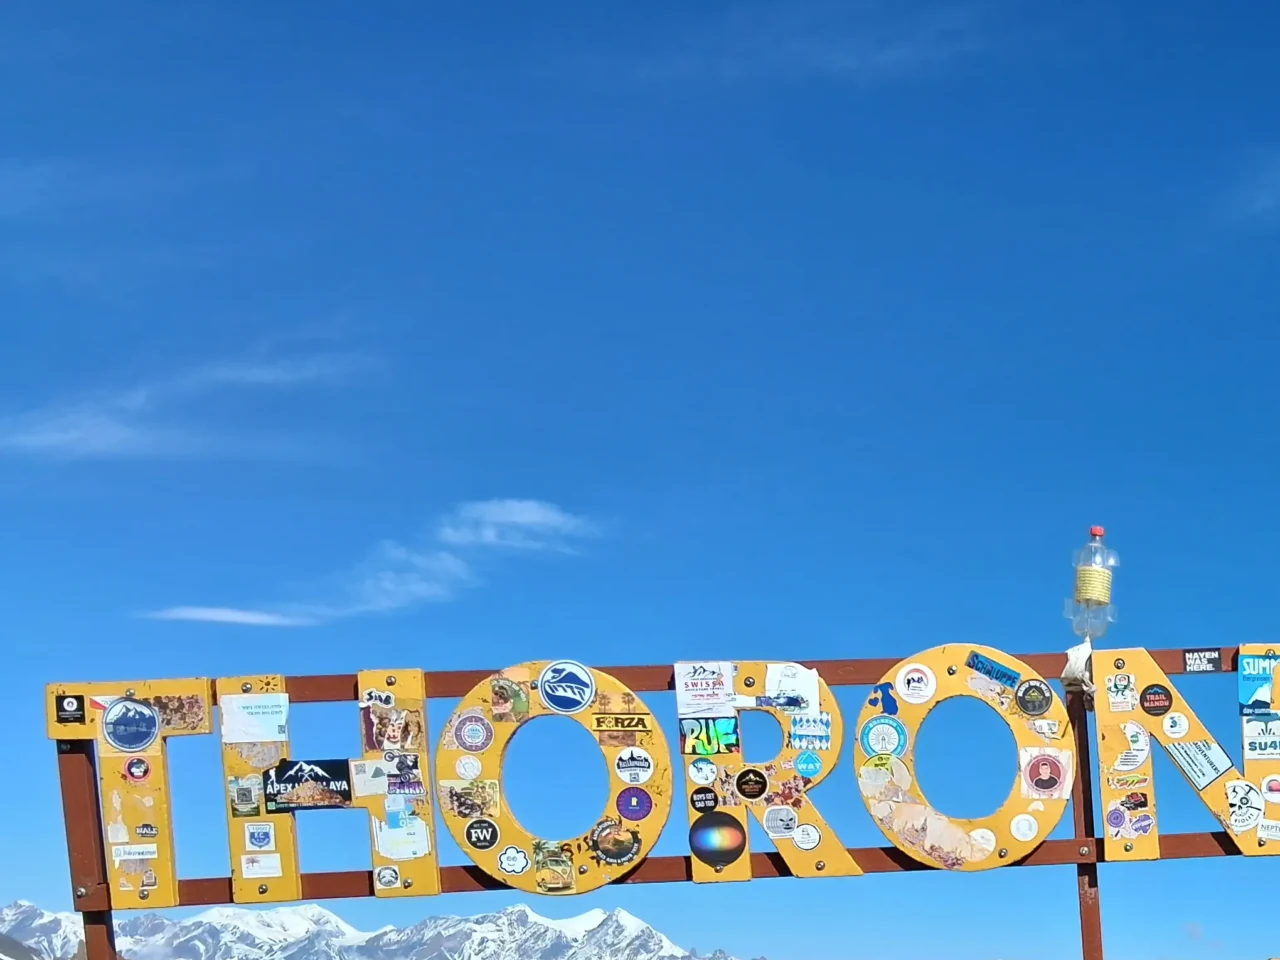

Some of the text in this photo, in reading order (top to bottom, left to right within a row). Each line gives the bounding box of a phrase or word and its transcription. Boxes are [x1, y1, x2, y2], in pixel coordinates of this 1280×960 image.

[1144, 700, 1169, 708] MANDU
[595, 716, 648, 730] FORZA
[266, 782, 292, 794] APEX
[470, 828, 492, 841] FW
